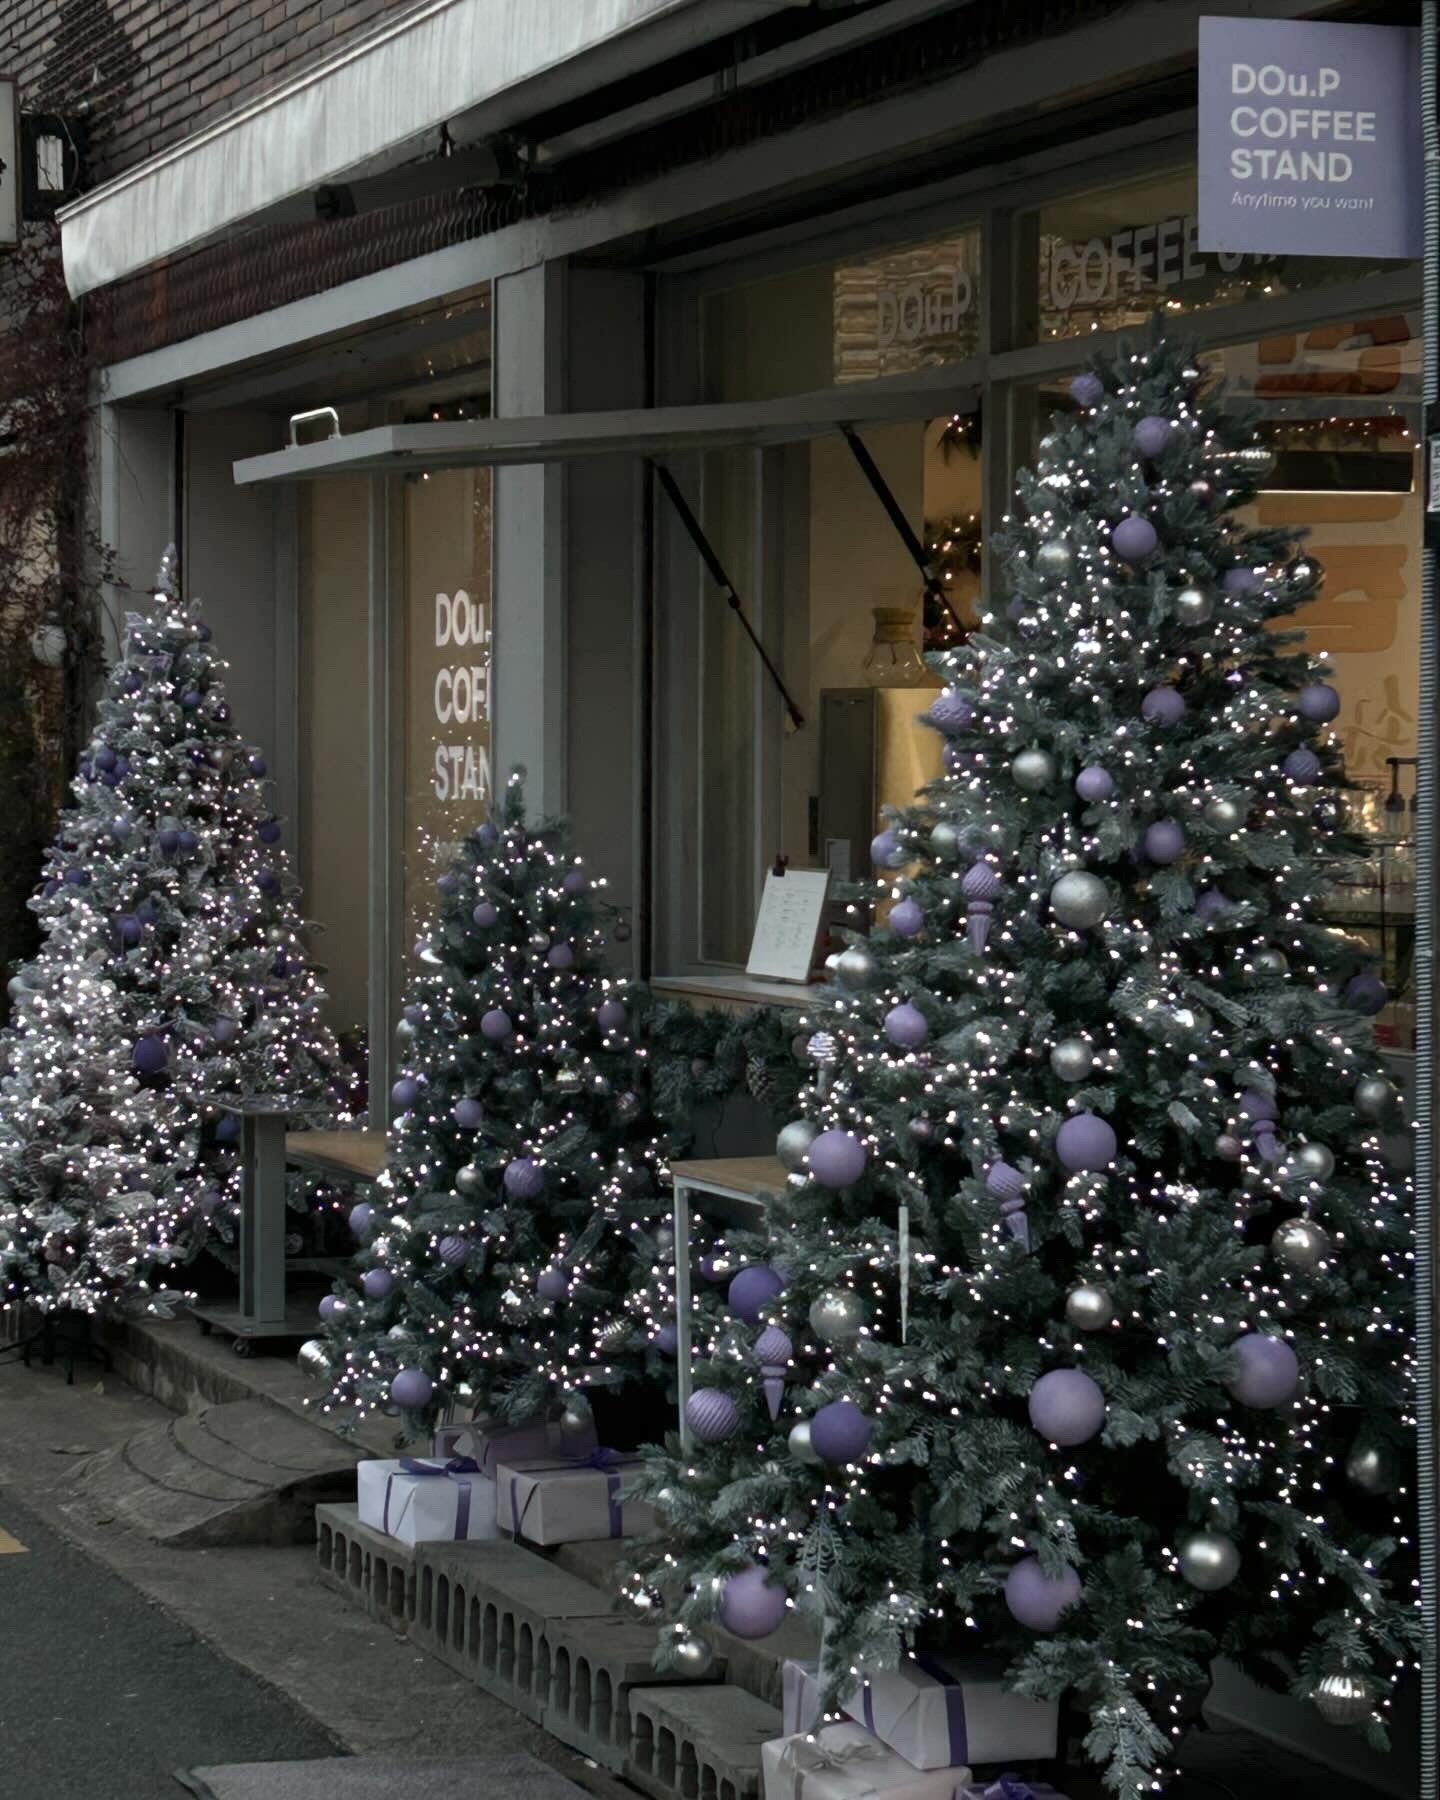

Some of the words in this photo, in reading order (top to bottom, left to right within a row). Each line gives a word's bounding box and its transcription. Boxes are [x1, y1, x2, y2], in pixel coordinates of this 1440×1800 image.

[1231, 63, 1341, 97] DOu.P
[1230, 106, 1377, 142] COFFEE
[1230, 148, 1353, 182] STAND
[1231, 191, 1297, 209] Anytime
[1301, 195, 1331, 211] you
[1335, 197, 1374, 209] want
[1051, 215, 1206, 309] COFFEE
